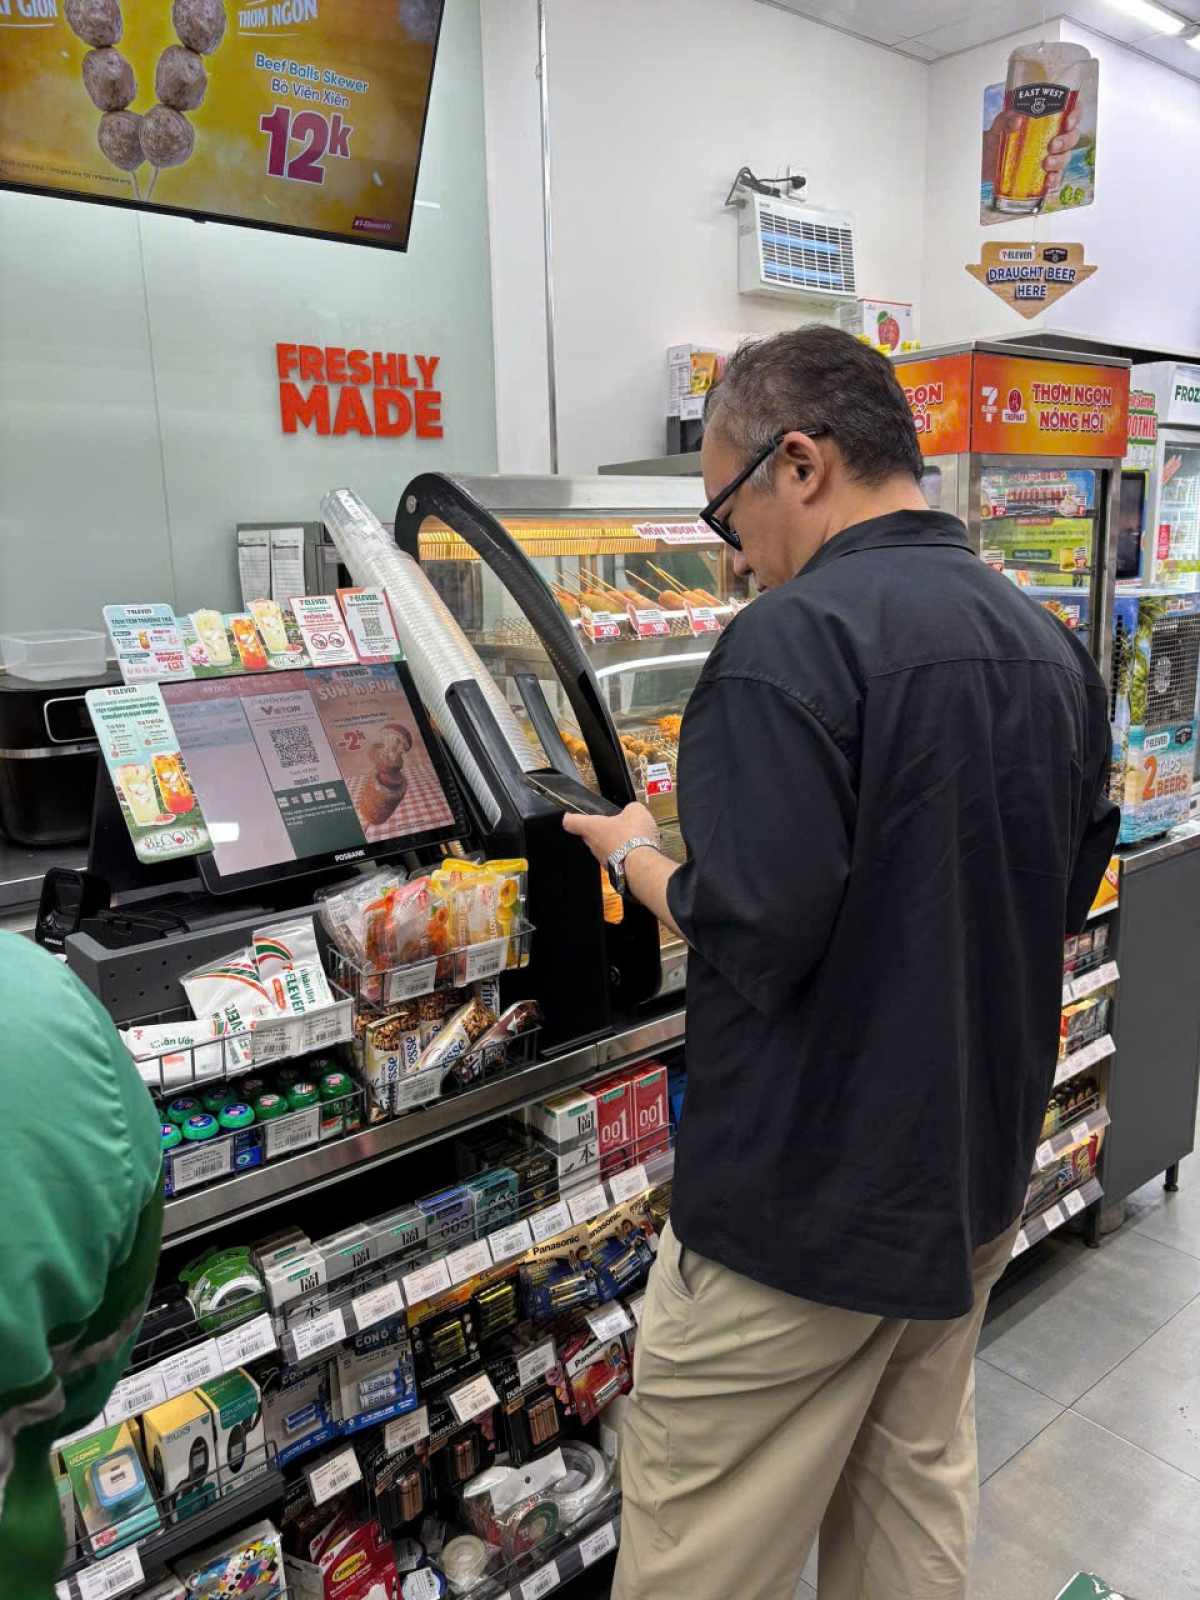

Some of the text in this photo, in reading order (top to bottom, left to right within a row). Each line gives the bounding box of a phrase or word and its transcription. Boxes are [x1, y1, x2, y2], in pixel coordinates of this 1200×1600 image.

[255, 53, 369, 93] Beef Balls Skewer
[271, 78, 350, 108] Bò Viên Xiên
[1019, 87, 1065, 99] EAST WEST
[259, 105, 352, 186] 12k
[988, 266, 1076, 284] DRAUGHT BEER
[1016, 285, 1047, 298] HERE
[276, 343, 440, 389] FRESHLY
[280, 382, 443, 439] MADE
[1039, 407, 1079, 431] NÓNG
[1141, 754, 1158, 801] 2
[1158, 758, 1181, 778] TAPS
[334, 849, 366, 862] POSBANK
[589, 1210, 622, 1240] anasonic
[533, 1234, 581, 1257] Panasonic
